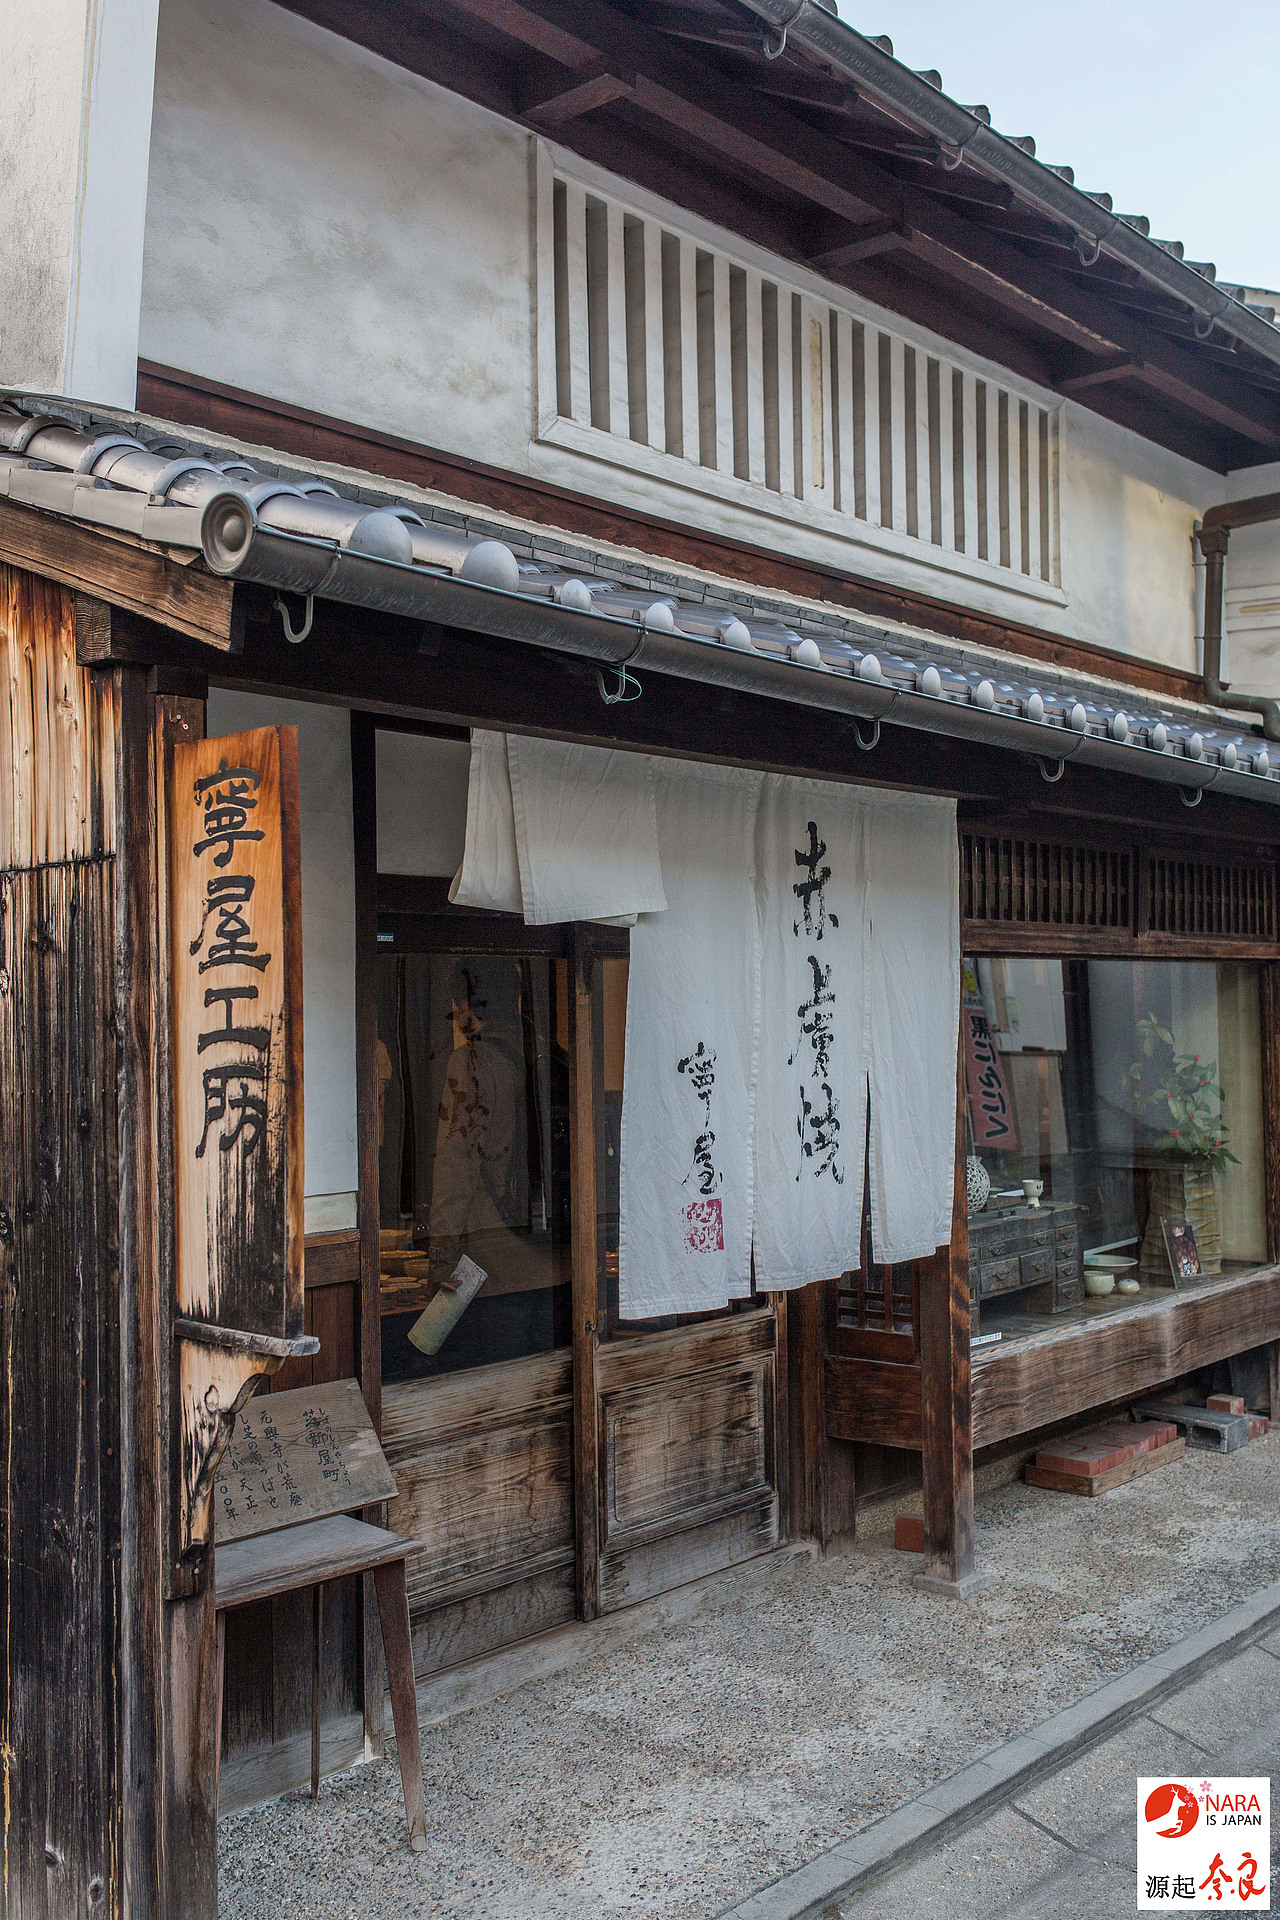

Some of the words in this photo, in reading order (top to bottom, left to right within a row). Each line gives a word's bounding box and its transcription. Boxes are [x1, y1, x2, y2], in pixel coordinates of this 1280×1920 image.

[189, 758, 271, 1158] 寧屋工房
[259, 1410, 303, 1508] 元興寺が荒廃
[302, 1408, 340, 1483] 芝新屋町
